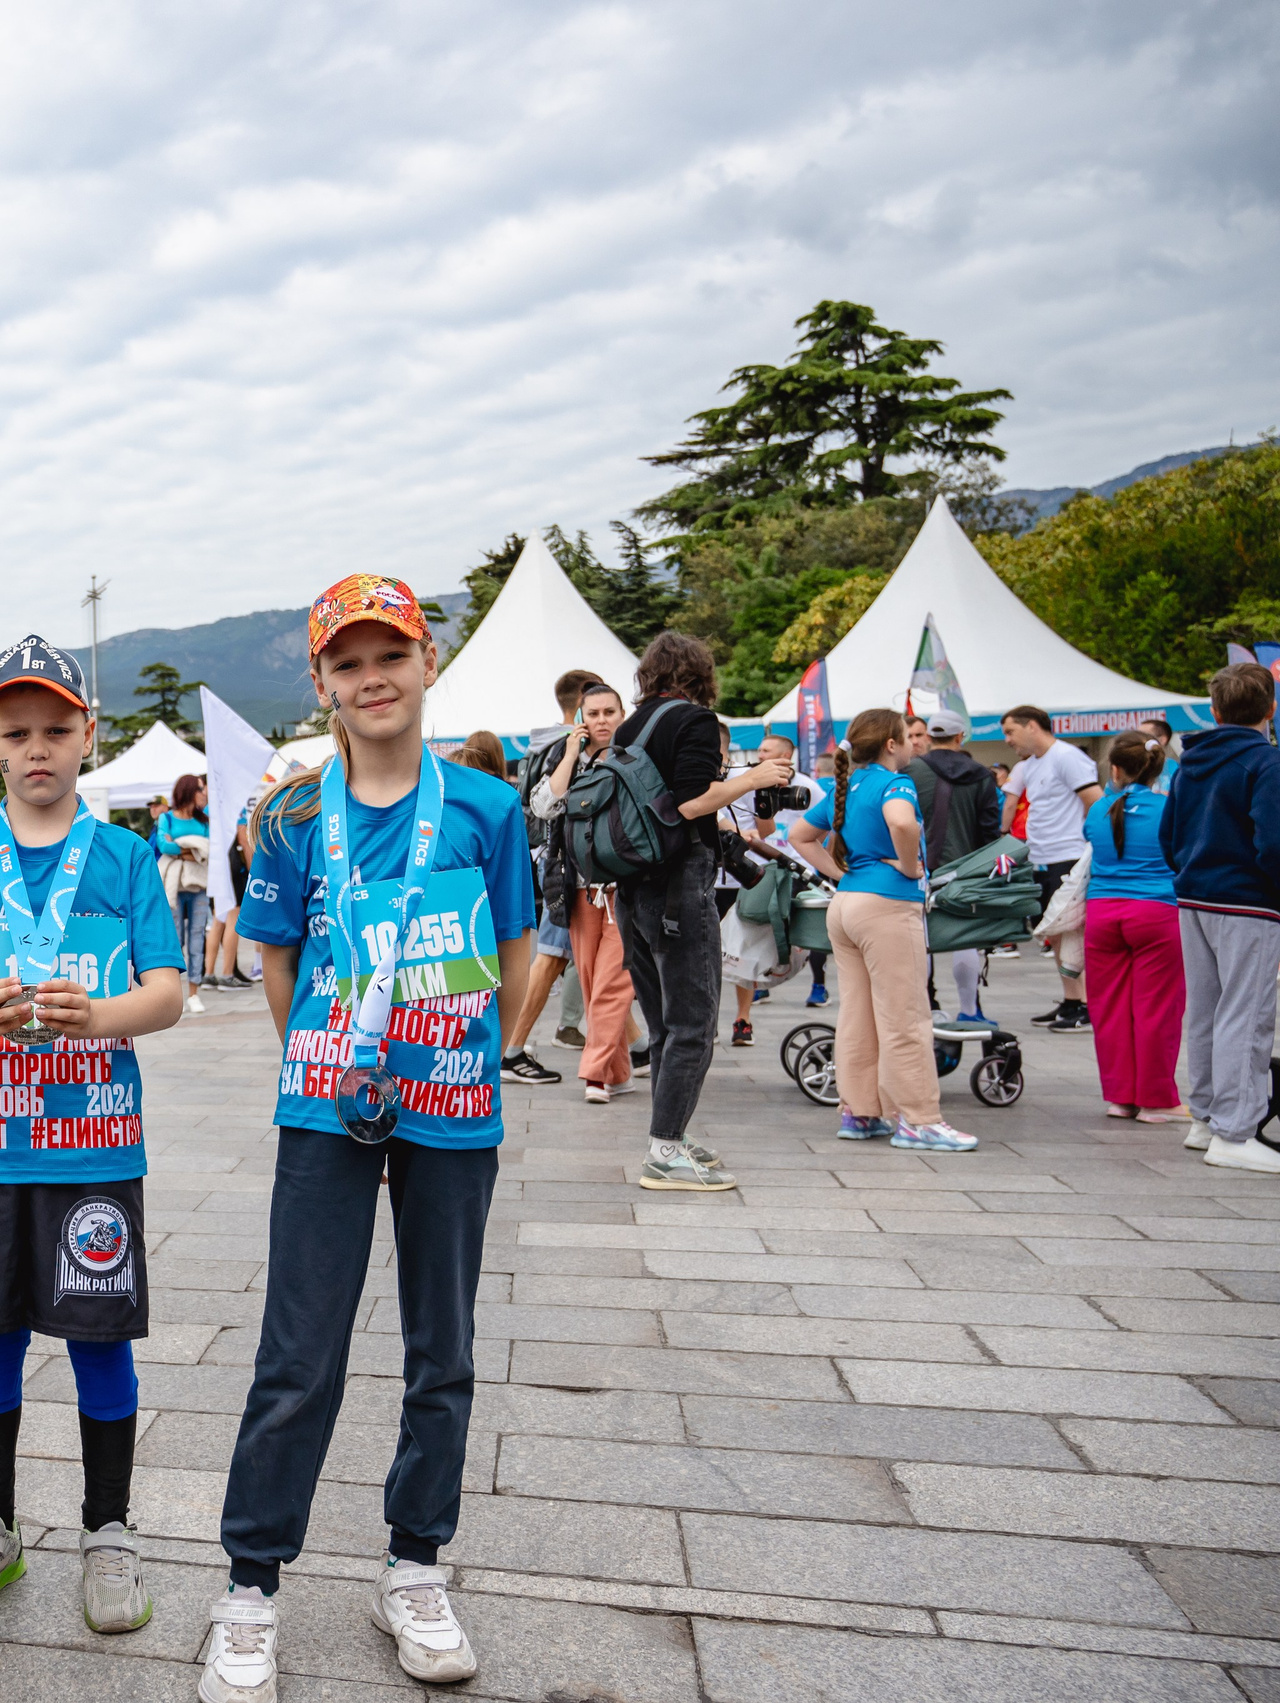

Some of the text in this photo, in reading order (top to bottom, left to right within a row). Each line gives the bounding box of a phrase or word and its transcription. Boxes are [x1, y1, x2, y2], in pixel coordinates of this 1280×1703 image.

[39, 641, 73, 683] SERVICE
[328, 813, 340, 842] ПСБ
[0, 854, 12, 873] ПСБ
[67, 847, 81, 865] ПСБ
[415, 838, 429, 866] ПСБ
[351, 889, 369, 902] СБ
[361, 911, 465, 966] 10255
[395, 962, 449, 1001] 1КМ
[429, 1049, 484, 1085] 2024
[86, 1083, 134, 1116] 2024
[31, 1113, 142, 1149] #ЕДИНСТВО
[81, 1204, 125, 1226] ПАНКРАТИОНА
[116, 1233, 127, 1261] РОССИИ
[60, 1248, 133, 1292] ПАНКРАТИОН
[395, 1571, 428, 1583] TIME JUMP
[228, 1608, 264, 1619] TIME JUMP
